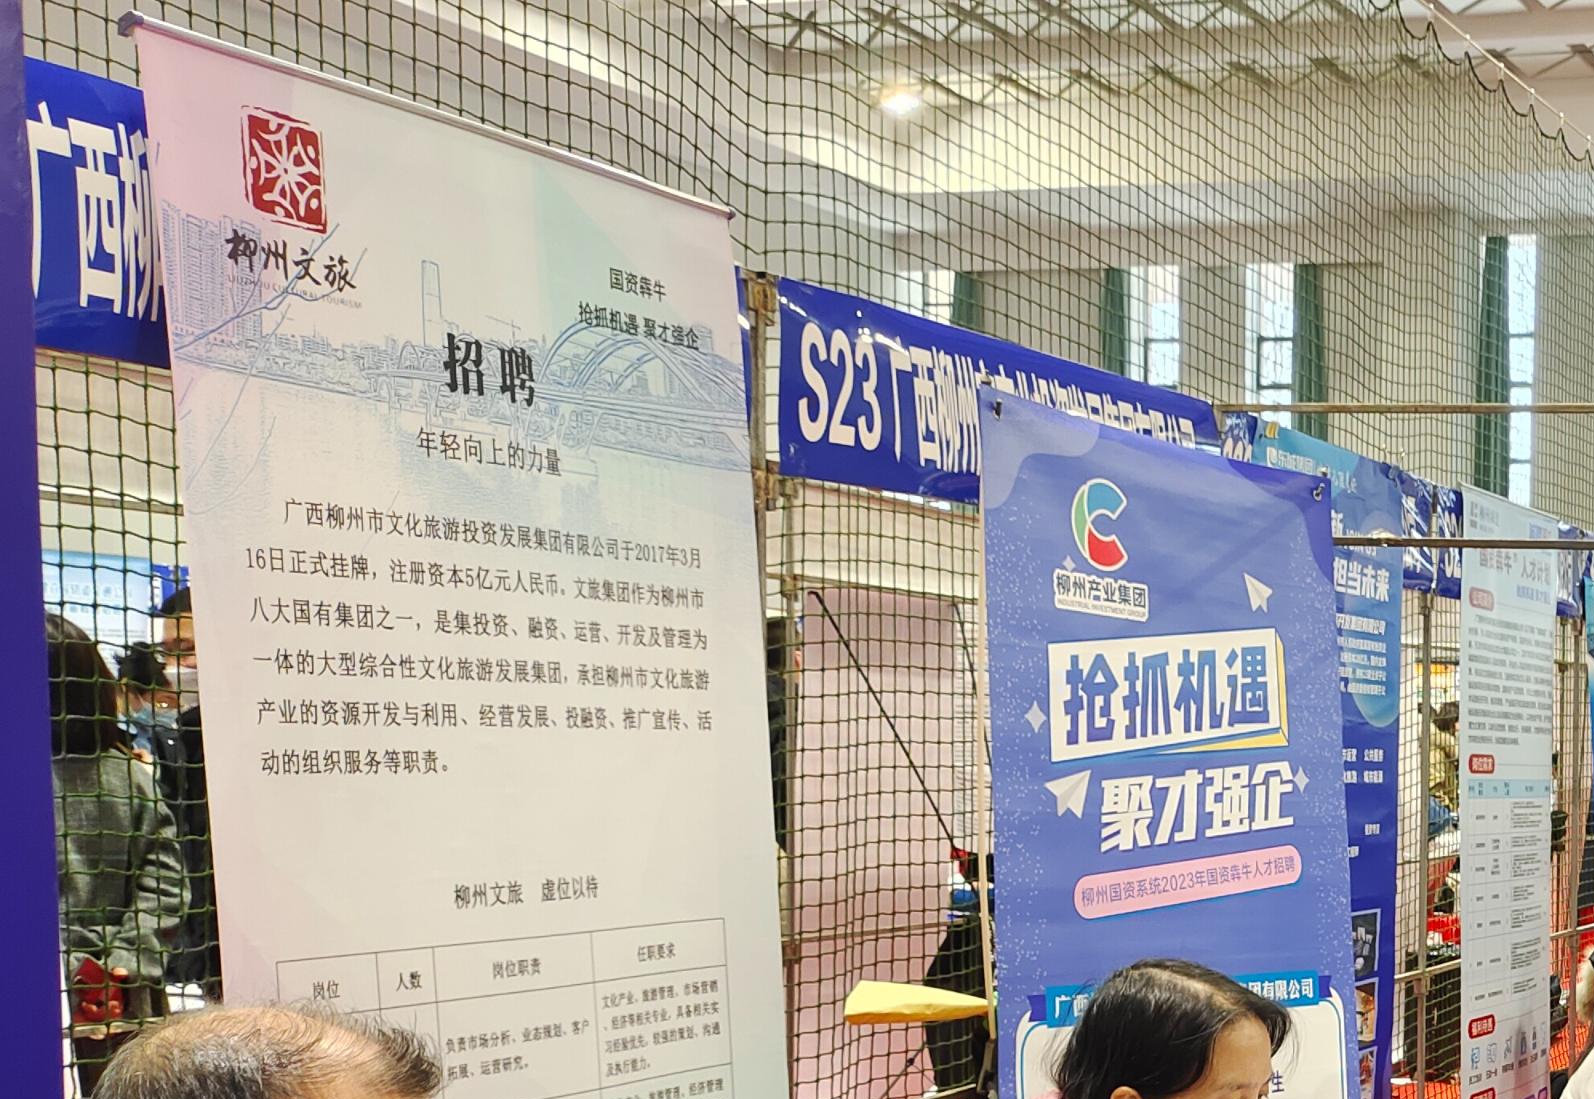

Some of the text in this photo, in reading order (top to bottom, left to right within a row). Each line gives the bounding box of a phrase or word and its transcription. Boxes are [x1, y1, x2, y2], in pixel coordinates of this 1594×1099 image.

[225, 229, 356, 292] 柳州文旅
[578, 300, 699, 350] 抢抓机遇 聚才强企
[443, 333, 535, 407] 招聘
[799, 322, 883, 450] S23
[416, 427, 562, 477] 年轻向上的力量
[283, 498, 702, 569] 广西柳州市文化旅游投资发展集团有限公司于2017年3月
[245, 548, 704, 609] 16日正式挂牌，注册资本5亿元人民币。文旅集团作为柳州市
[1056, 572, 1146, 608] 柳州产业集团
[1333, 556, 1390, 602] 担当未来
[250, 597, 708, 651] 八大国有集团之一，是集投资、融资、运营、开发及管理为
[257, 699, 712, 731] 产业的资源开发与利用、经营发展、投融资、推广宣传、活
[1065, 646, 1270, 746] 抢抓机遇
[261, 749, 451, 776] 动的组织服务等职责。
[1100, 761, 1294, 853] 聚才强企
[454, 876, 598, 910] 柳州文旅 虚位以待
[492, 958, 541, 980] 岗位职责
[637, 943, 676, 963] 任职要求
[312, 980, 341, 1000] 岗位
[396, 971, 422, 992] 人数
[1241, 979, 1314, 1000] 团有限公司
